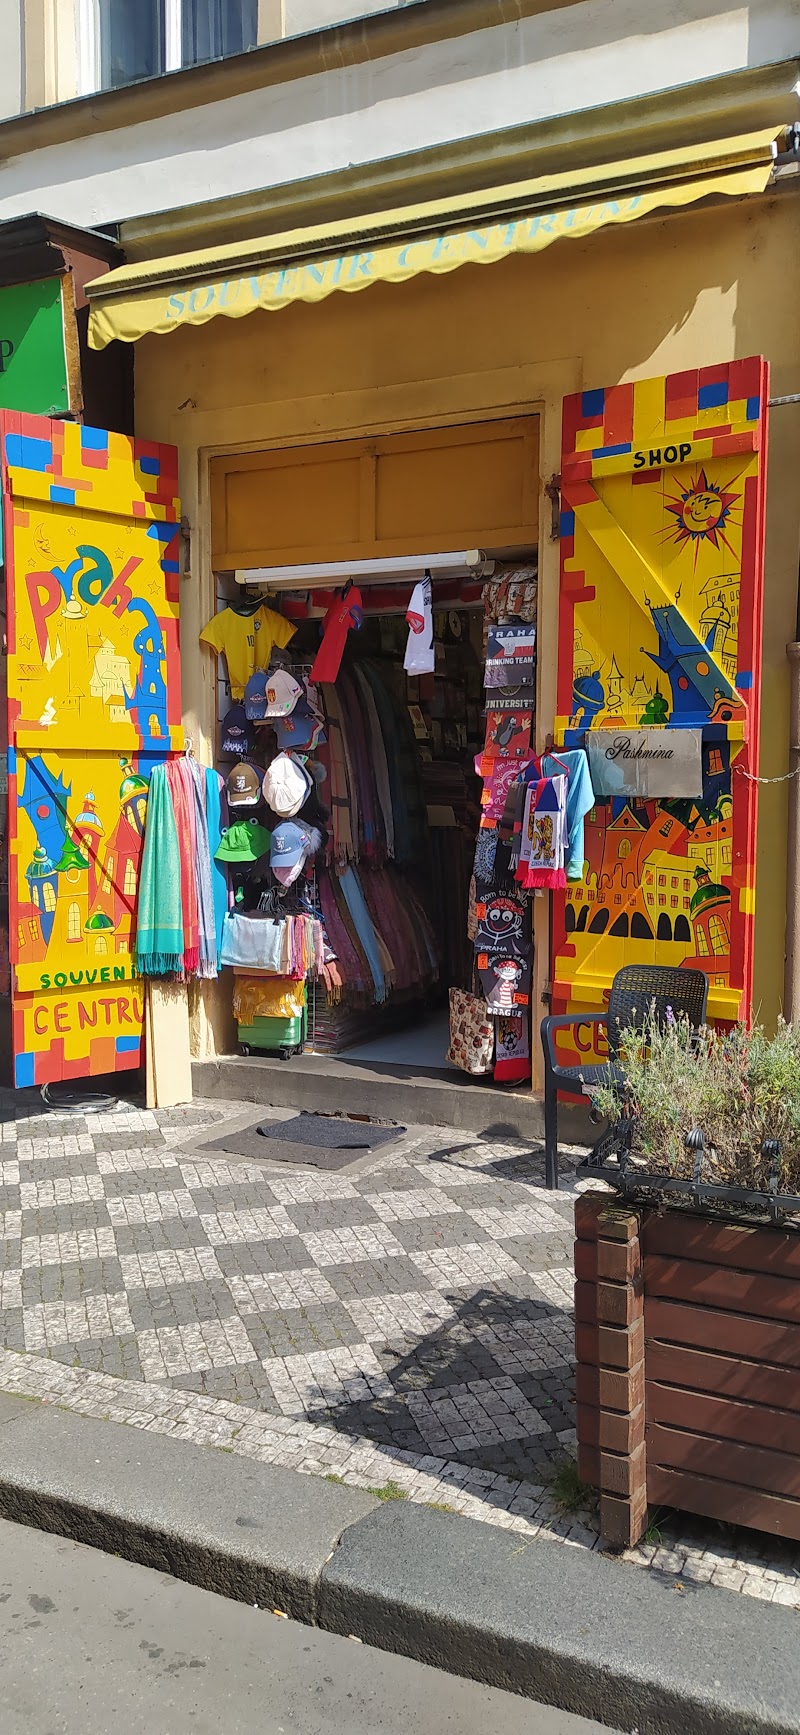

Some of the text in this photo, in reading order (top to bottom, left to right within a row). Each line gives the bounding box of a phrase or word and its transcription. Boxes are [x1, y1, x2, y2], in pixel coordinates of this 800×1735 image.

[165, 195, 642, 319] SOUVENIR CENTRUM
[633, 443, 692, 469] SHOP
[487, 629, 536, 638] PRAHA
[515, 656, 533, 664] TEAM
[605, 735, 674, 760] Pashmina
[487, 1007, 523, 1018] PRAGUE
